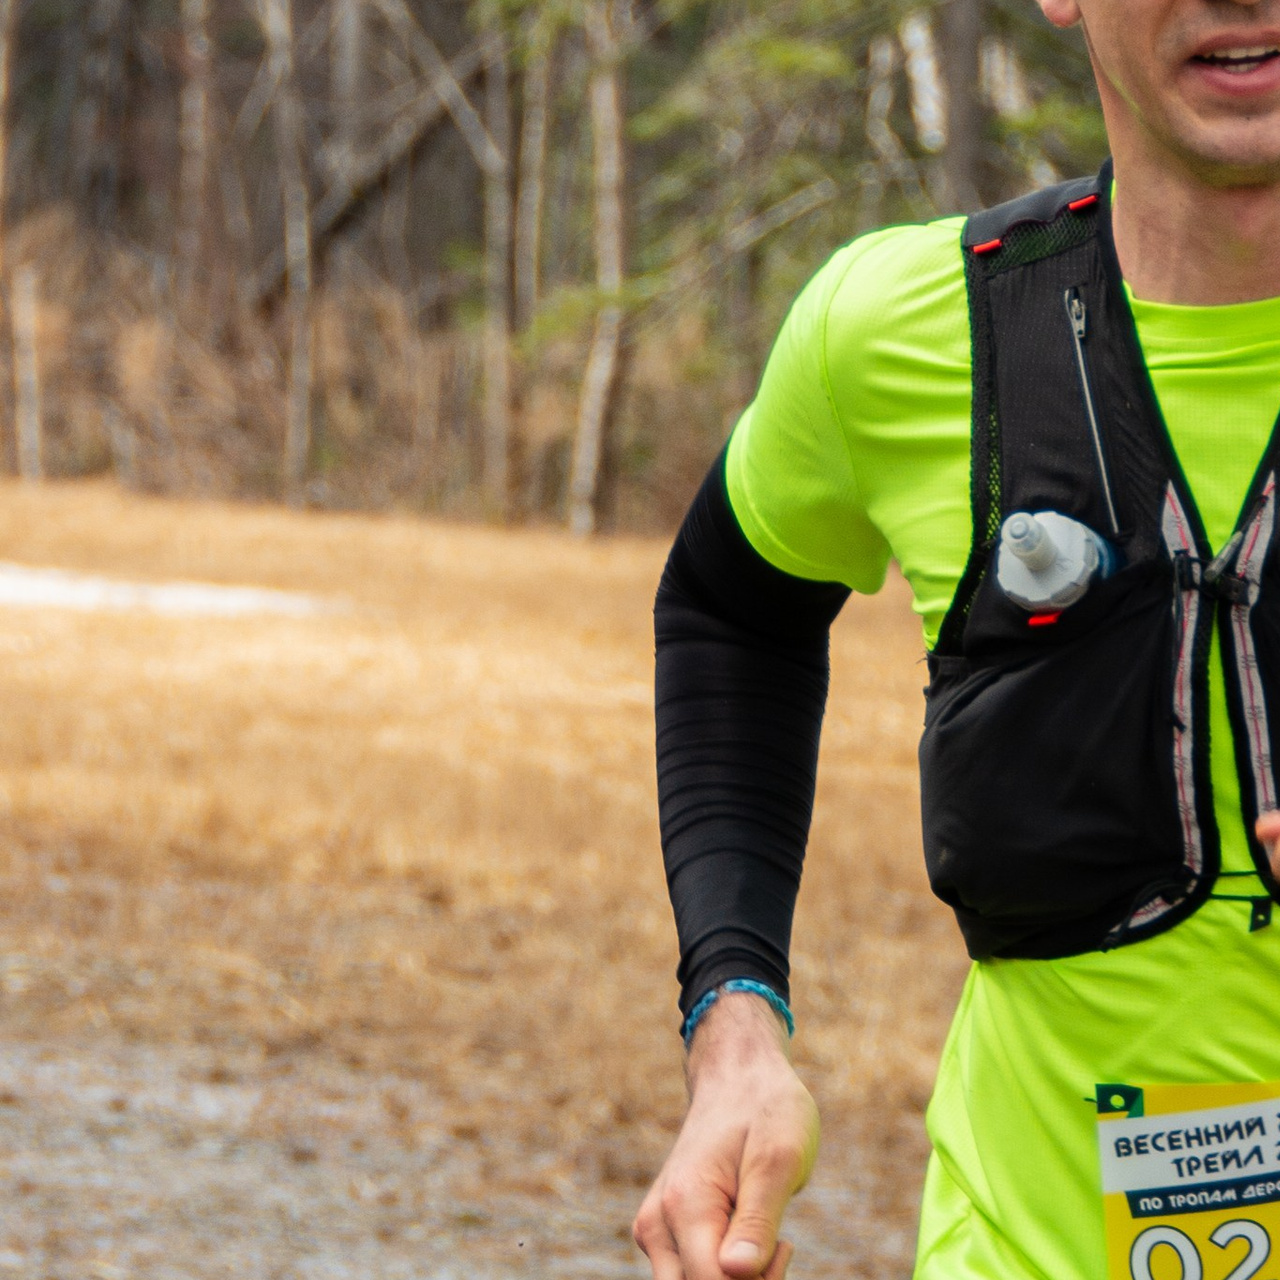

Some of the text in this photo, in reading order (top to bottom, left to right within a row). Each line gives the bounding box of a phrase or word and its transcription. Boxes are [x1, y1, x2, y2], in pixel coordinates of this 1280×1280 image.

[1114, 1116, 1266, 1157] ВЕСЕННИЙ
[1171, 1145, 1264, 1177] ТРЕЙЛ
[1139, 1197, 1163, 1211] ПО
[1168, 1189, 1237, 1208] ТРОПАМ
